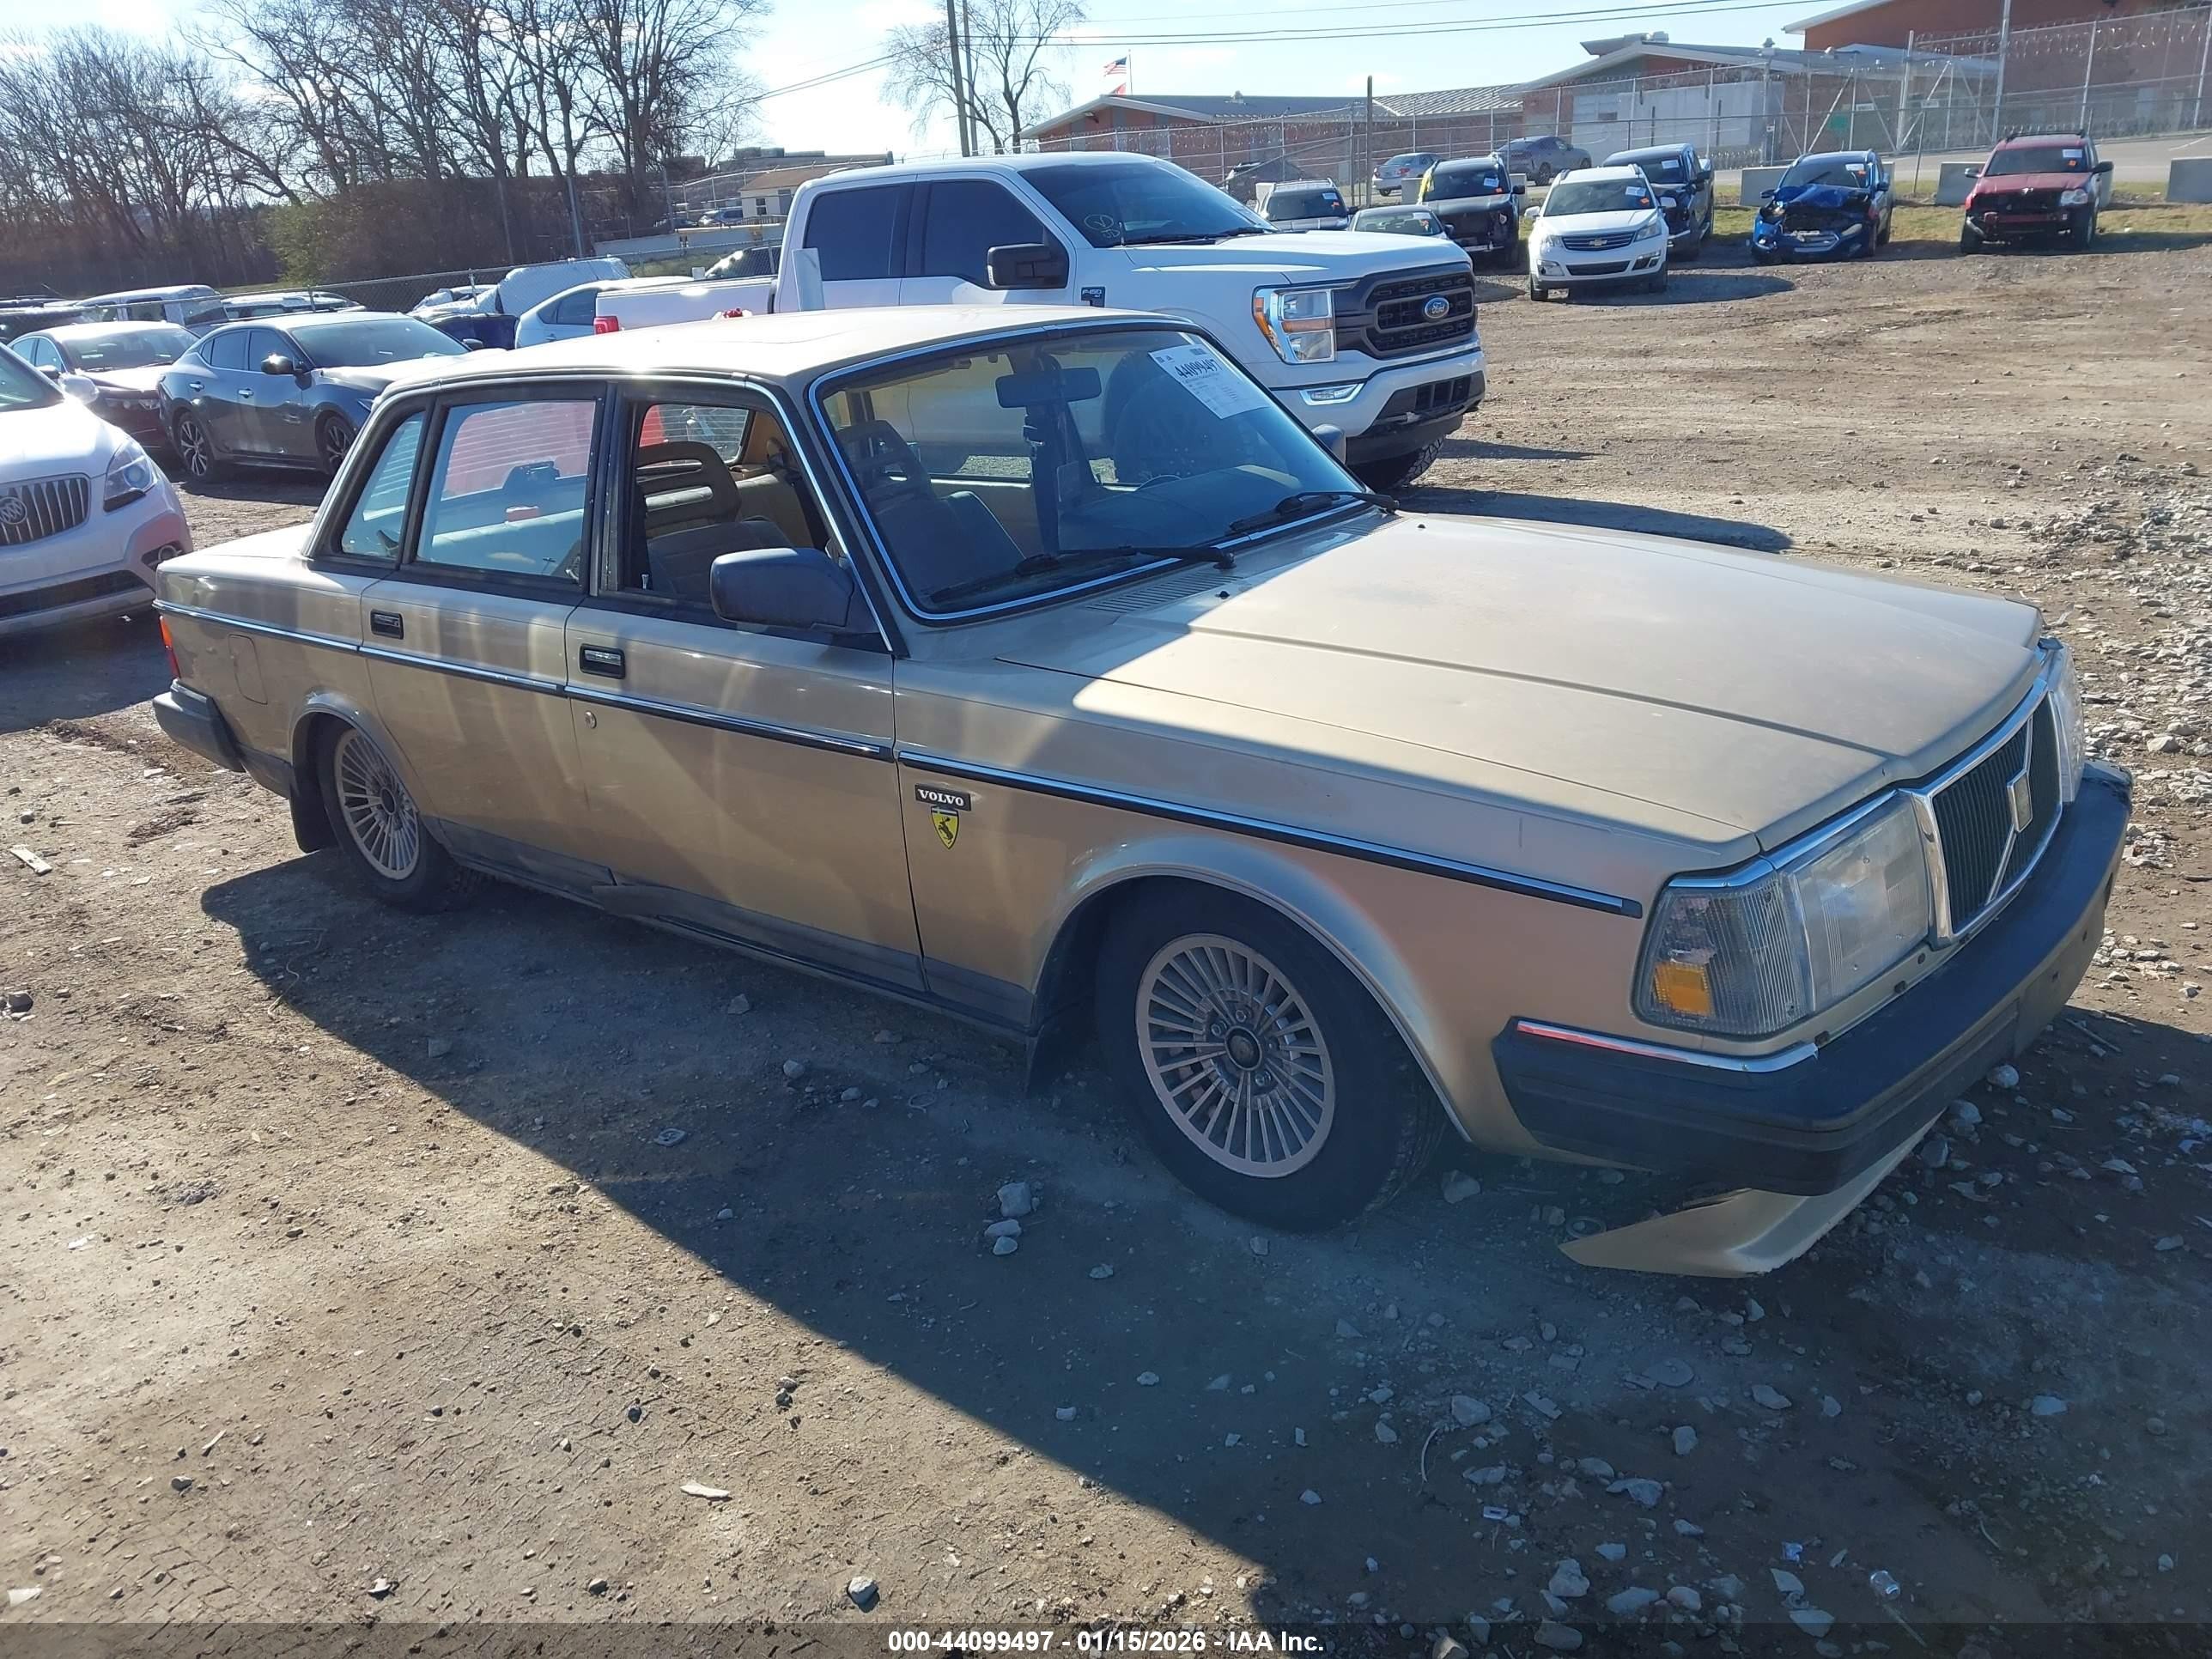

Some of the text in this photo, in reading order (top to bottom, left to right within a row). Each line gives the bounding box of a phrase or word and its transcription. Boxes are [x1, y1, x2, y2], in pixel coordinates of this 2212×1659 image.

[1431, 301, 1445, 314] Ford
[1174, 358, 1223, 379] 44099497
[917, 788, 965, 807] VOLVO
